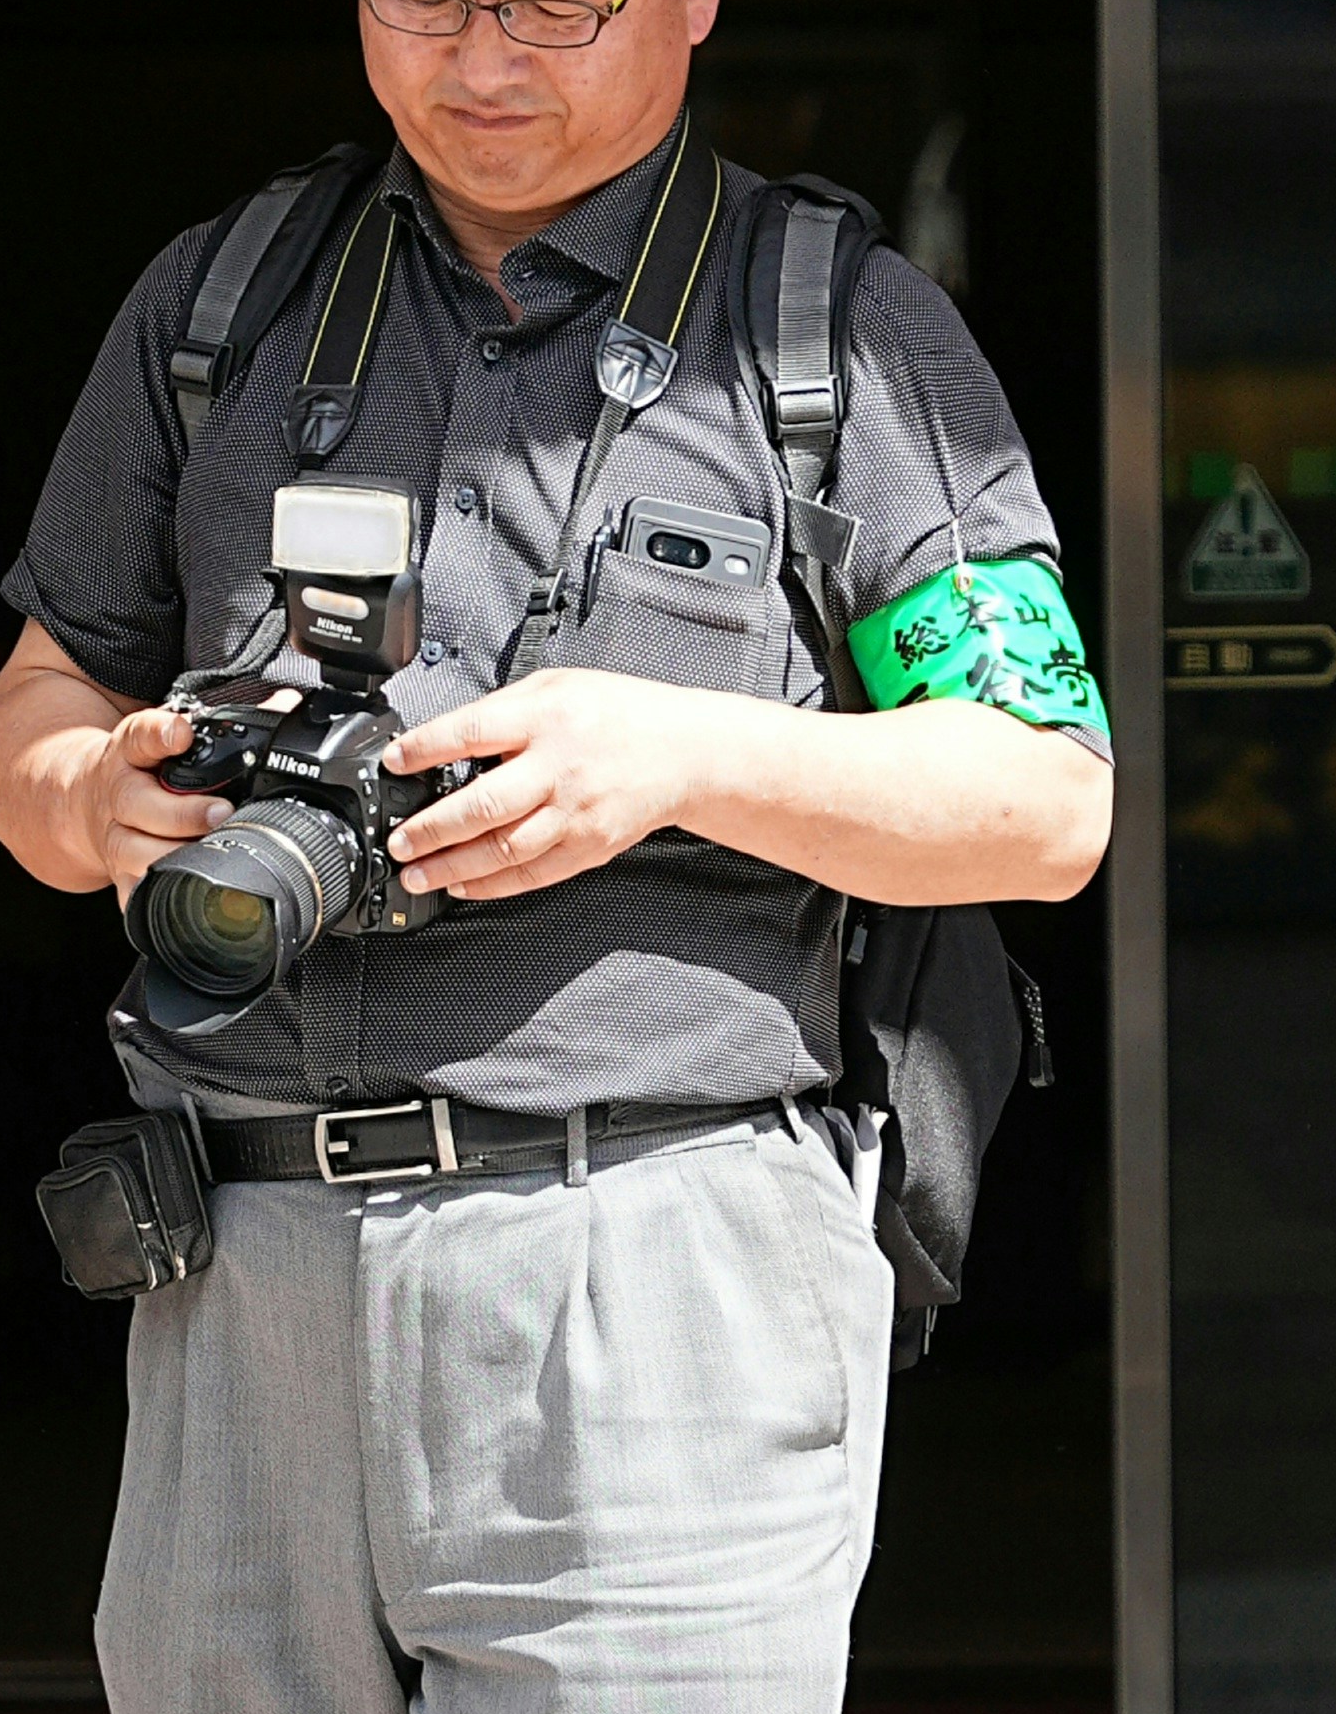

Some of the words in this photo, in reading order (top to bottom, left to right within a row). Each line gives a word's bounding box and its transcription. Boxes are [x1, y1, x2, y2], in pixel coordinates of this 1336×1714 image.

[316, 616, 354, 635] Nikon
[894, 593, 1051, 671] 総本山
[267, 751, 321, 779] Nikon
